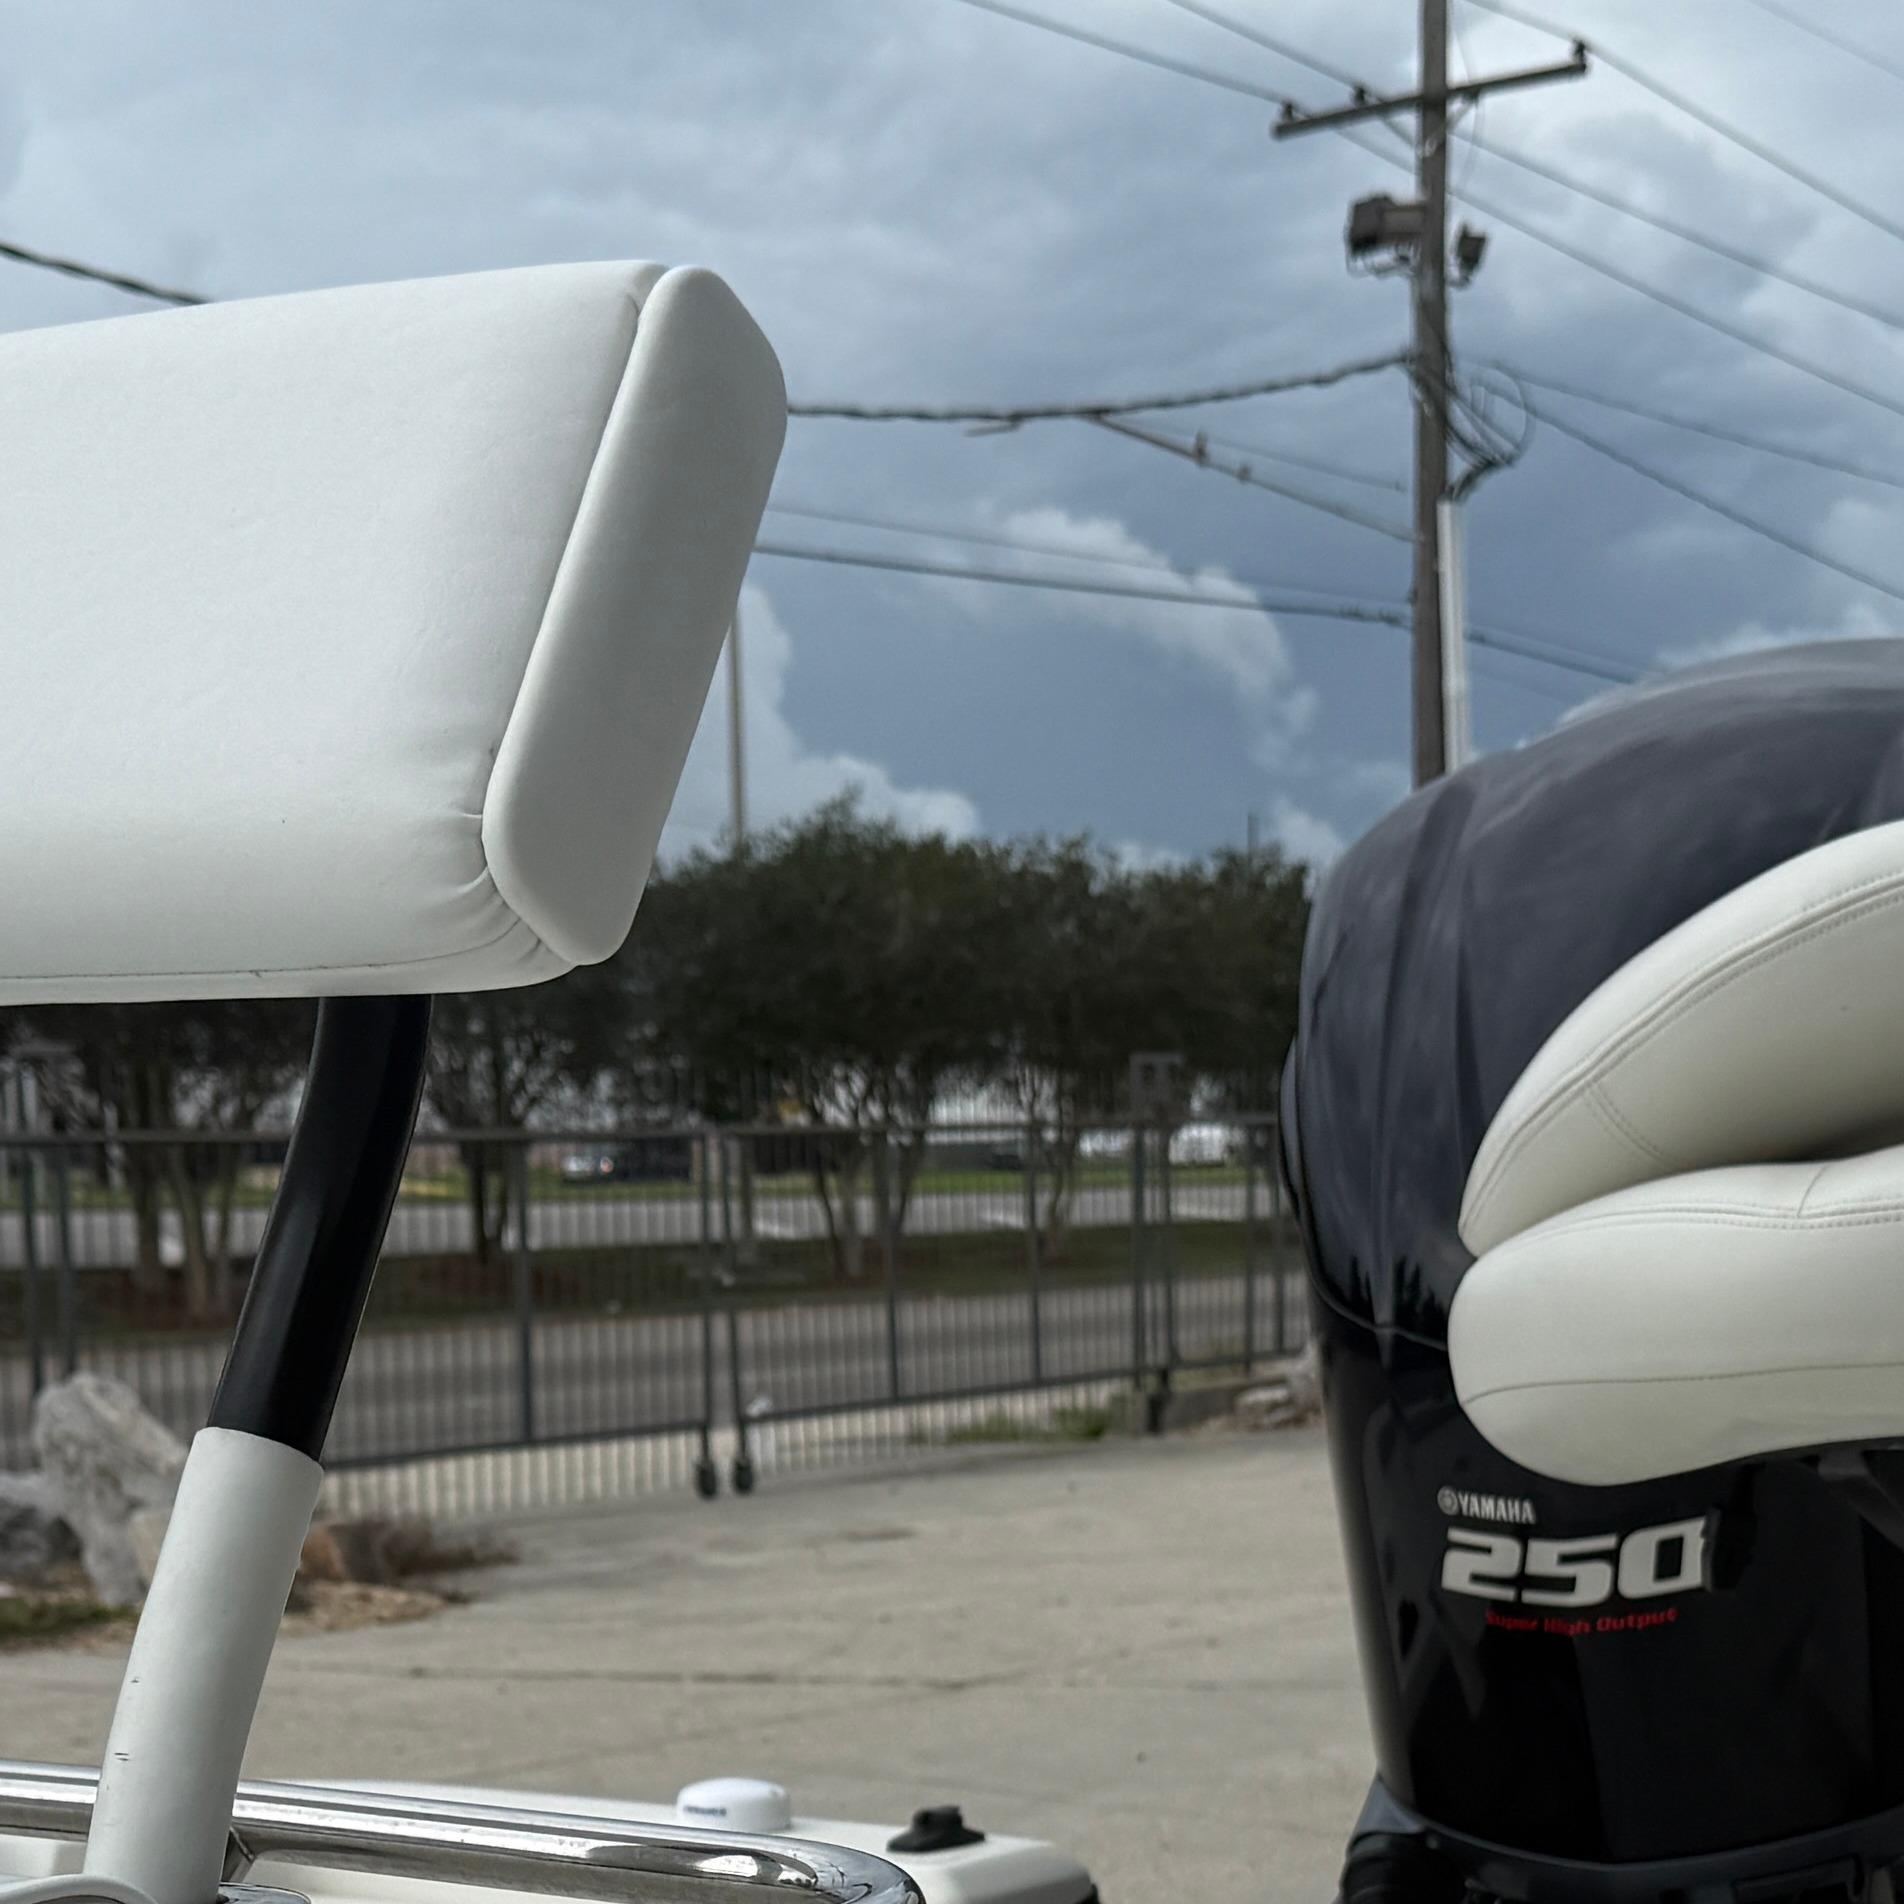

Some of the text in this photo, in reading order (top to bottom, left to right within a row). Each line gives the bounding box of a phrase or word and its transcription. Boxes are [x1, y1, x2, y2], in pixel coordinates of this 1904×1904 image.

[1457, 1492, 1536, 1525] YAMAHA
[1441, 1516, 1706, 1607] 250
[1544, 1617, 1591, 1636] High
[1597, 1607, 1677, 1631] Output
